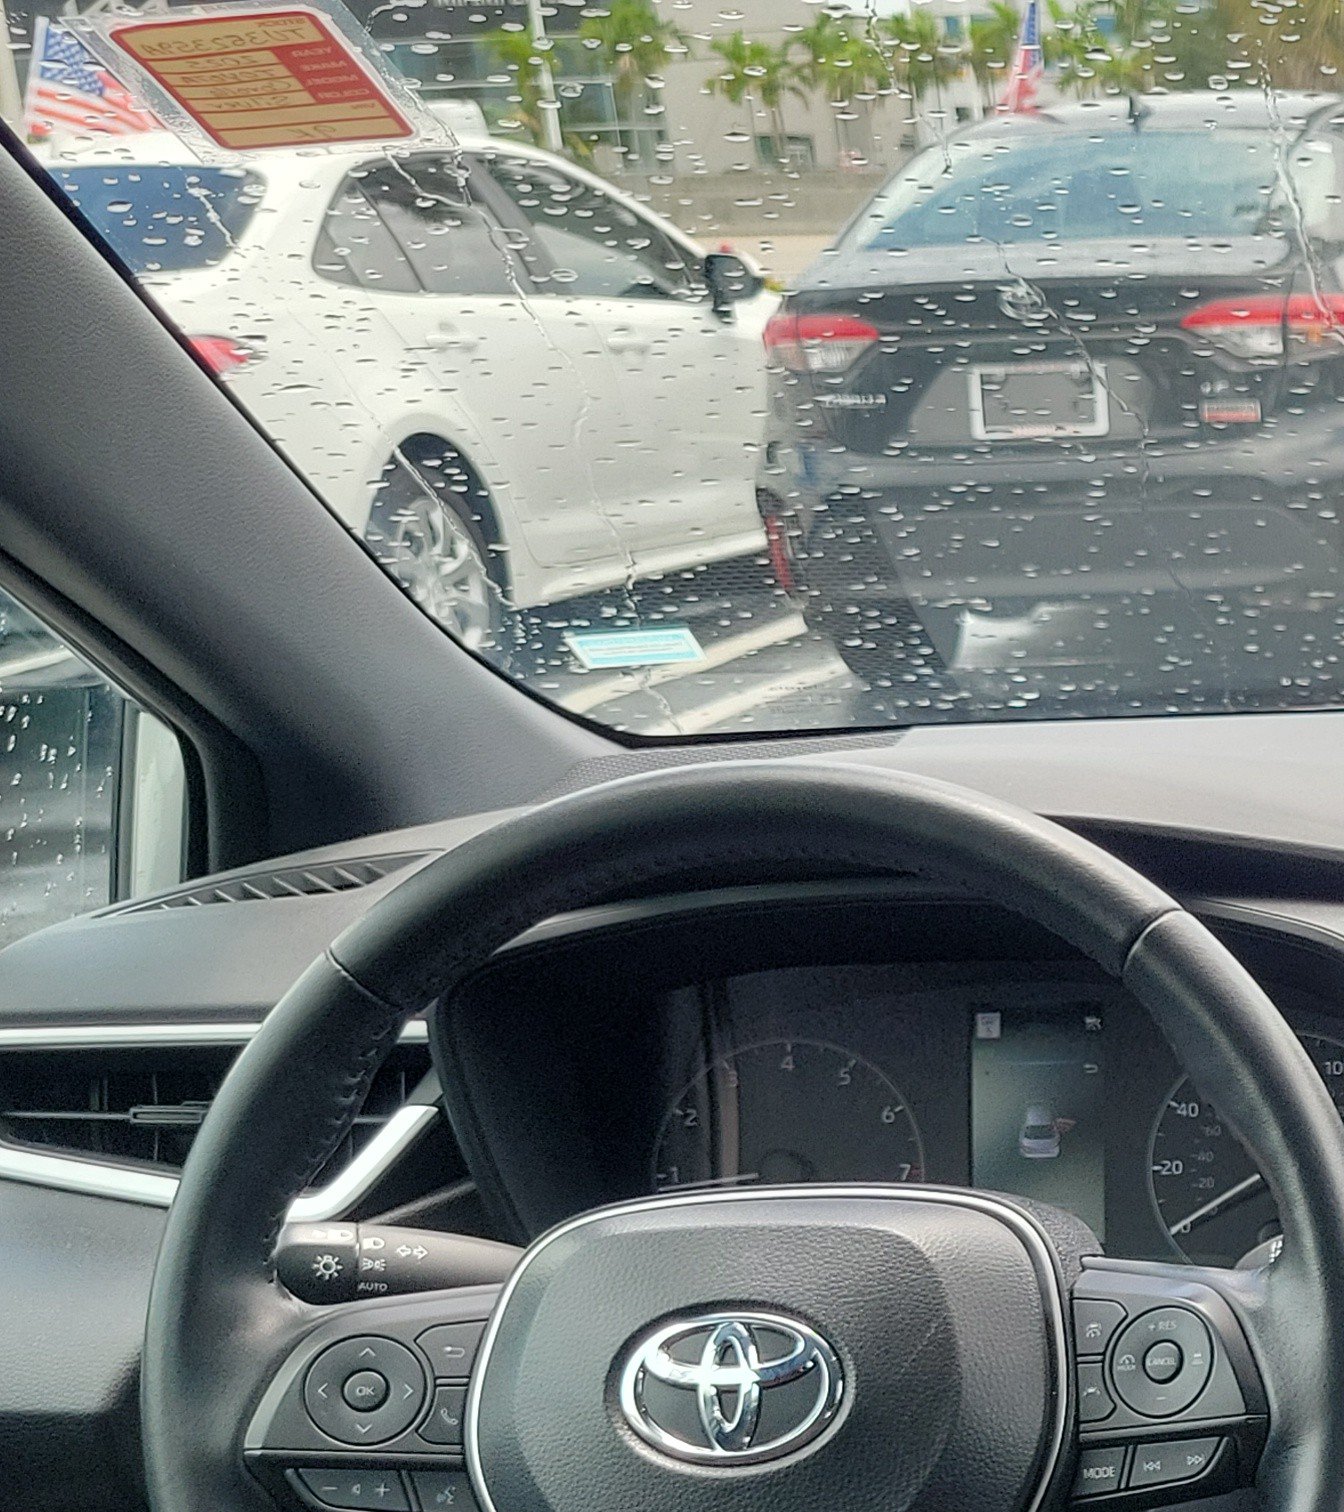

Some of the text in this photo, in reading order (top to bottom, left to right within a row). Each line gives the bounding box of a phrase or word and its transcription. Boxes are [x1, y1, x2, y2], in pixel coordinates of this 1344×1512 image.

[781, 1055, 795, 1071] 4
[727, 1070, 738, 1088] 3
[838, 1068, 850, 1086] 5
[684, 1108, 698, 1126] 2
[881, 1106, 895, 1123] 6
[1176, 1102, 1199, 1117] 40
[670, 1166, 679, 1182] 1
[899, 1163, 911, 1181] 7
[1160, 1160, 1183, 1175] 20
[358, 1282, 388, 1291] AUTO
[1147, 1357, 1176, 1367] CANCEL
[356, 1386, 375, 1397] OK
[1083, 1466, 1116, 1480] MODE
